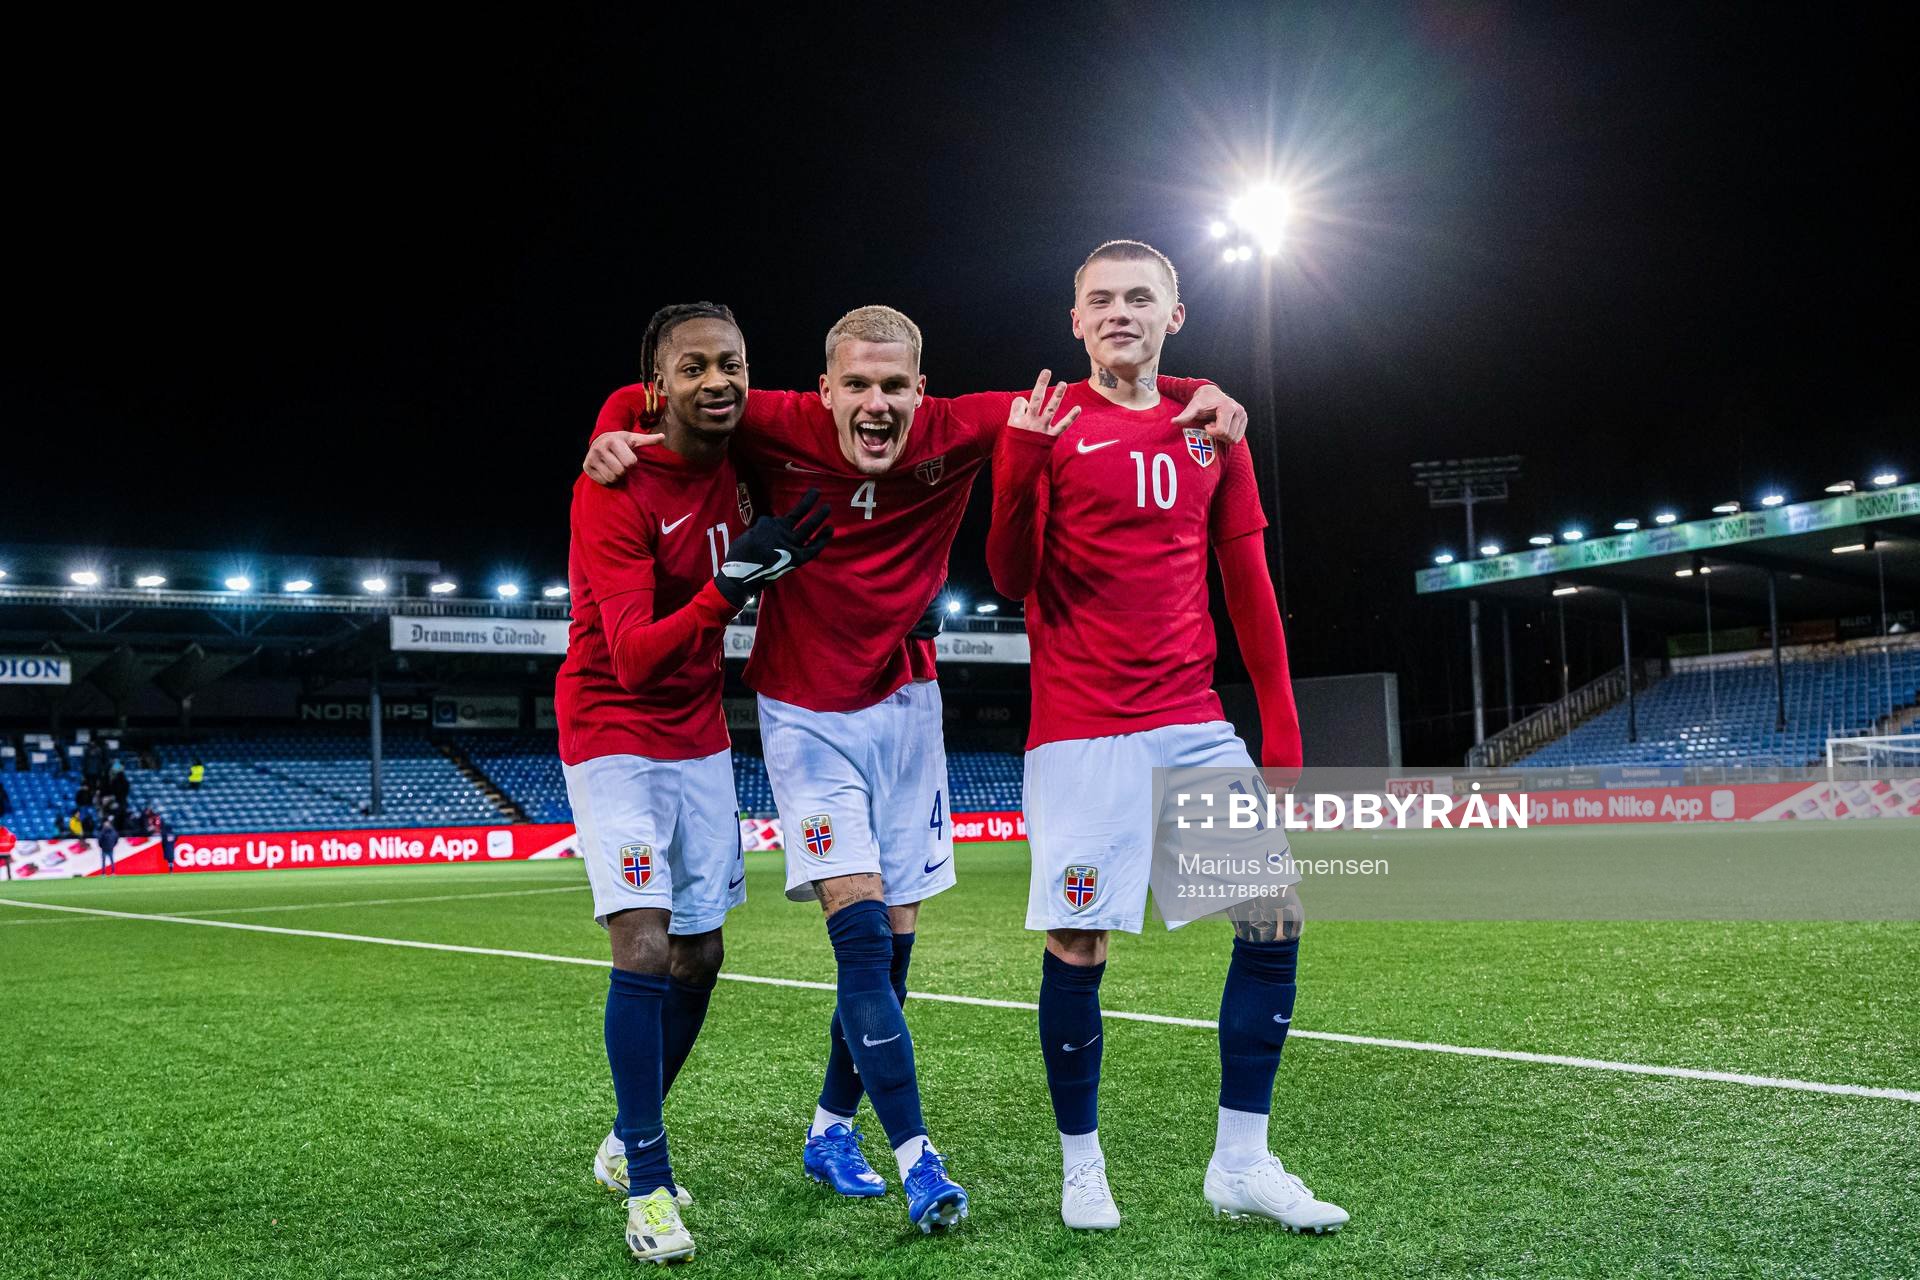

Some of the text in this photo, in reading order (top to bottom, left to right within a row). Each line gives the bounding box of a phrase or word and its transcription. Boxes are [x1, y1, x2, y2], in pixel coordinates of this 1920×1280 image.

[1130, 451, 1177, 509] 10
[851, 480, 877, 520] 4
[706, 522, 729, 577] 11
[411, 624, 547, 646] Drammens Tidende
[953, 639, 993, 655] Tidende
[302, 704, 428, 719] NORIPS
[930, 790, 943, 840] 4
[1552, 798, 1569, 818] in
[1573, 796, 1603, 817] the
[1608, 796, 1655, 817] Nike
[1660, 794, 1703, 820] App
[988, 817, 1014, 840] Up
[174, 834, 479, 869] Gear Up in the Nike App
